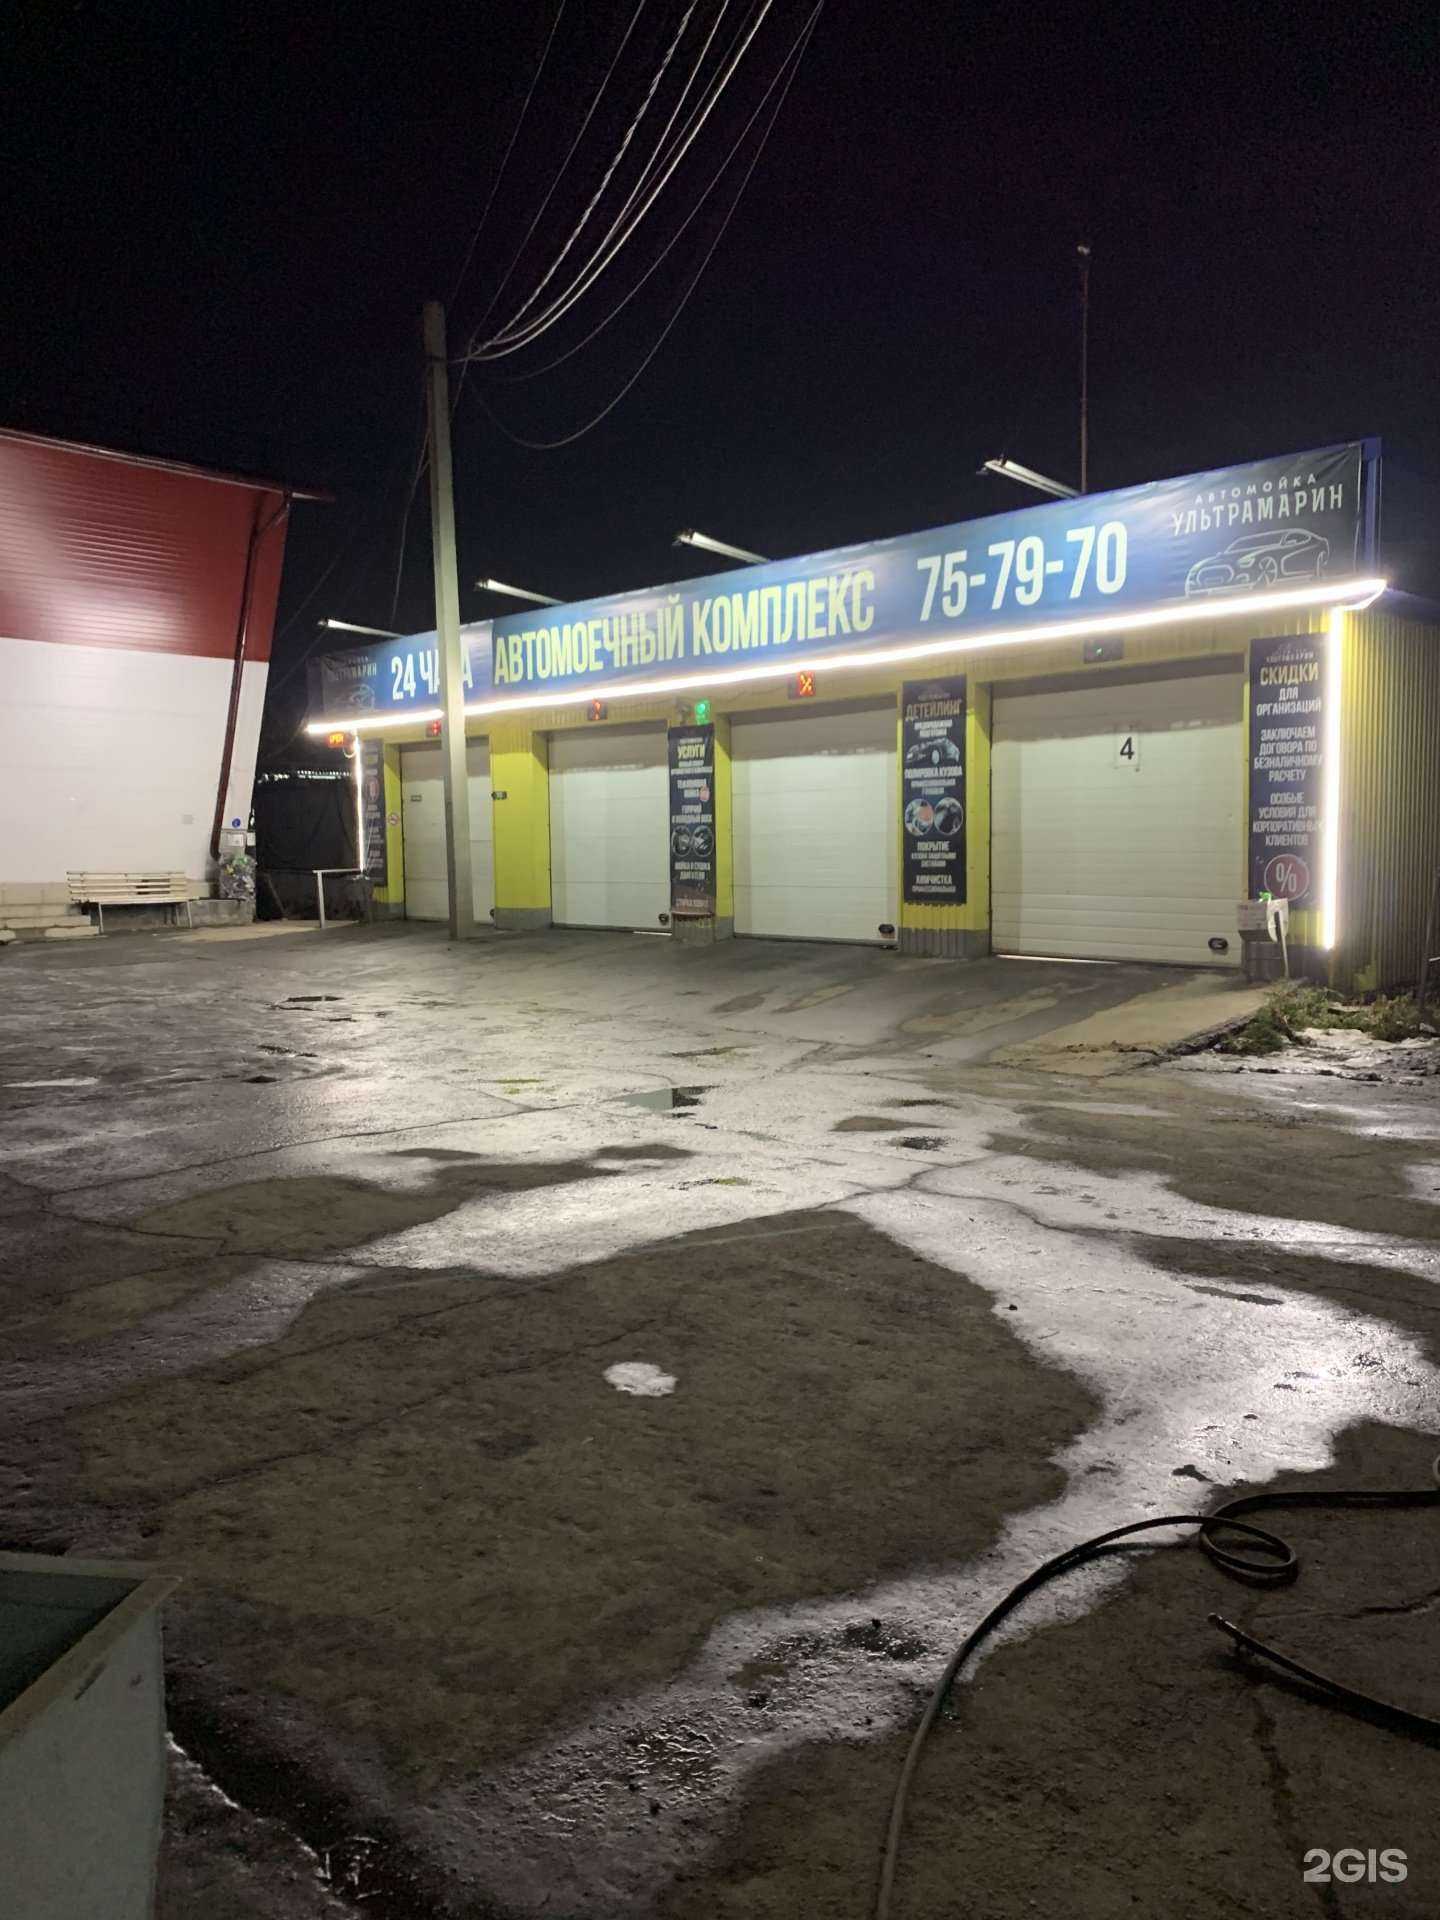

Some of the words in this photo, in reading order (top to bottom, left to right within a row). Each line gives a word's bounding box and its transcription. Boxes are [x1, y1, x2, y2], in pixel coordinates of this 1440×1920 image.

[1195, 473, 1317, 504] АВТОМОЙКА
[1171, 484, 1344, 536] УЛЬТРАМАРИН
[916, 521, 1128, 621] 75-79-70
[494, 593, 685, 685] АВТОМОЕЧНЫЙ
[693, 569, 875, 656] КОМПЛЕКС
[391, 654, 416, 700] 24
[1259, 662, 1319, 686] СКИДКИ
[1279, 687, 1299, 700] ДЛЯ
[1256, 697, 1322, 716] ОРГАНИЗАЦИЙ
[1261, 726, 1316, 741] ЗАКЛЮЧАЕМ
[1120, 736, 1135, 760] 4
[1259, 741, 1303, 756] ДОГОВОРА
[1268, 769, 1307, 782] РАСЧЕТУ
